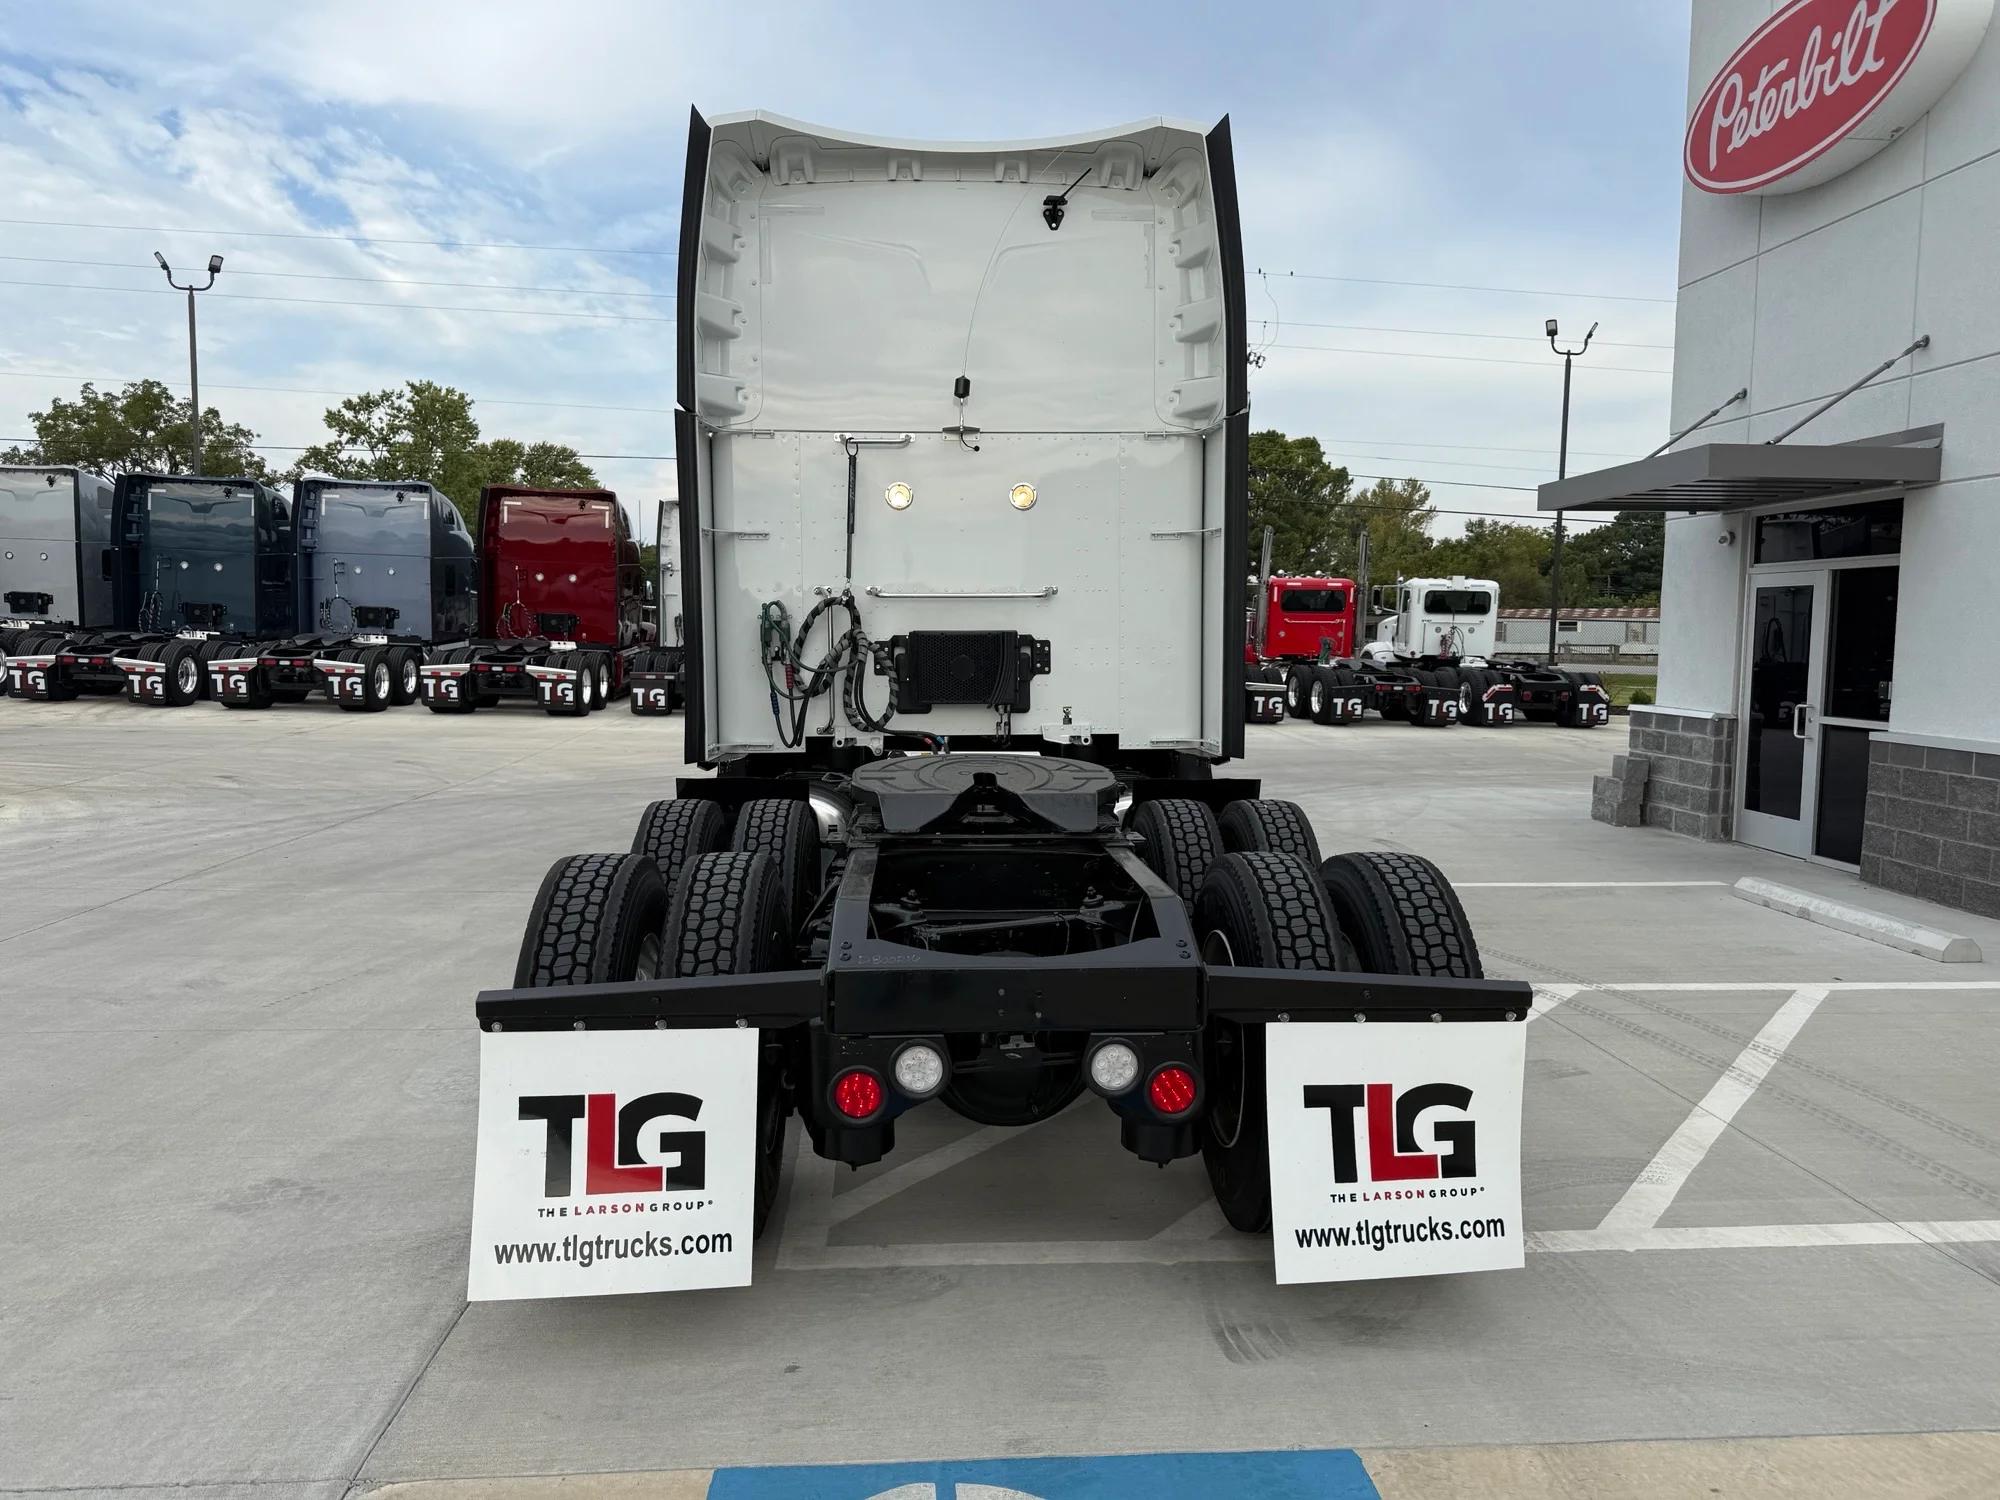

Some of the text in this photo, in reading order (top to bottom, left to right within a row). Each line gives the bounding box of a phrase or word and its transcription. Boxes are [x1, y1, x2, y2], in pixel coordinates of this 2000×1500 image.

[1709, 0, 1898, 171] Peterbilt
[518, 1091, 706, 1198] TLG
[1303, 1082, 1477, 1184] TLG
[537, 1207, 568, 1218] THE
[574, 1202, 645, 1216] LARSON
[1329, 1192, 1358, 1204] THE
[1362, 1189, 1425, 1202] LARSON
[494, 1230, 733, 1268] www.tlgtrucks.com
[1294, 1215, 1506, 1252] www.tlgtrucks.com
